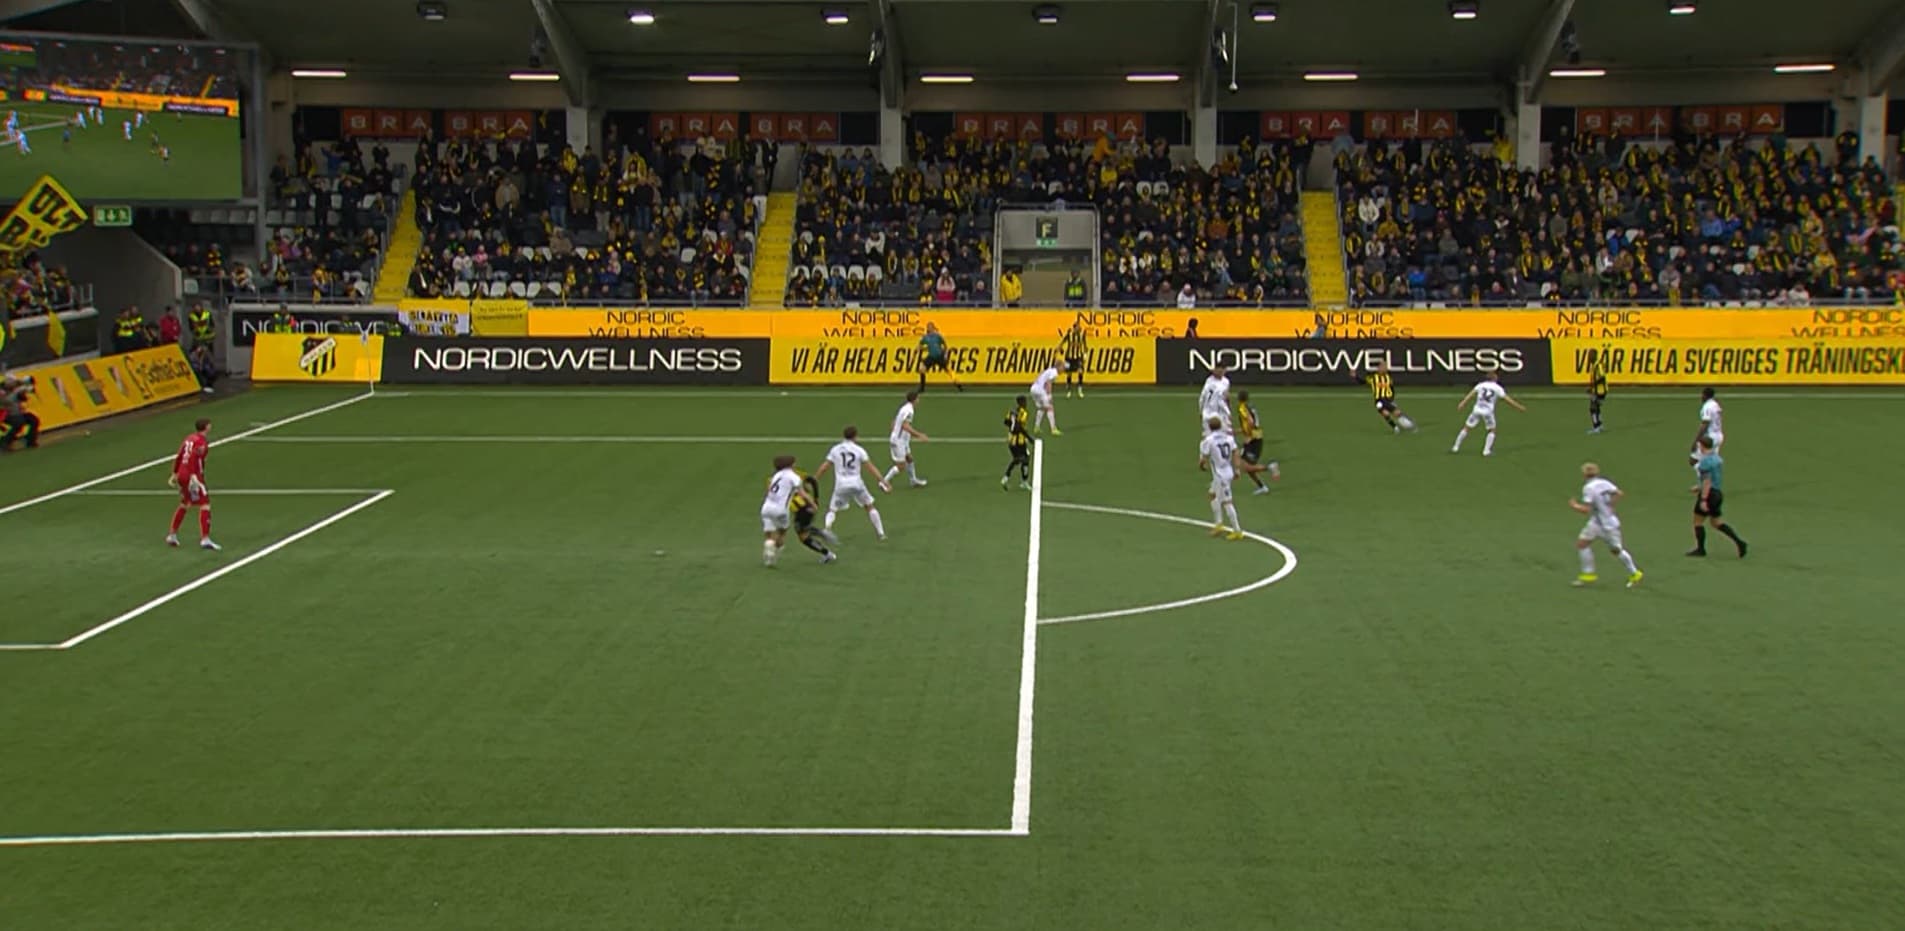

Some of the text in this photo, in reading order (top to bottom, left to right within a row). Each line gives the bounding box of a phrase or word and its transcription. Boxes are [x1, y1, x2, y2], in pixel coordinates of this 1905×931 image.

[351, 115, 427, 129] BRA
[453, 115, 528, 130] BRA
[758, 119, 832, 132] BRA
[1063, 119, 1137, 132] BRA
[1693, 112, 1774, 127] BRA
[1042, 222, 1053, 238] F
[607, 310, 685, 325] NORDIC
[843, 310, 921, 325] NORDIC
[1077, 310, 1155, 325] NORDIC
[1315, 311, 1394, 325] NORDIC
[1558, 310, 1641, 325] NORDIC
[1813, 309, 1903, 324] NORDIC
[589, 327, 705, 338] WELLNESS
[824, 327, 927, 337] WELLNES
[1538, 327, 1662, 338] WELLNESS
[413, 347, 743, 371] NORDICWELLNESS
[791, 348, 809, 373] VI
[812, 343, 839, 373] ÄR
[843, 348, 888, 373] HELA
[1189, 348, 1525, 372] NORDICWELLNESS
[1599, 343, 1625, 373] ÄR
[1630, 348, 1678, 373] HELA
[1684, 347, 1779, 374] SVERIGES
[840, 451, 857, 470] 12
[770, 477, 781, 494] 6
